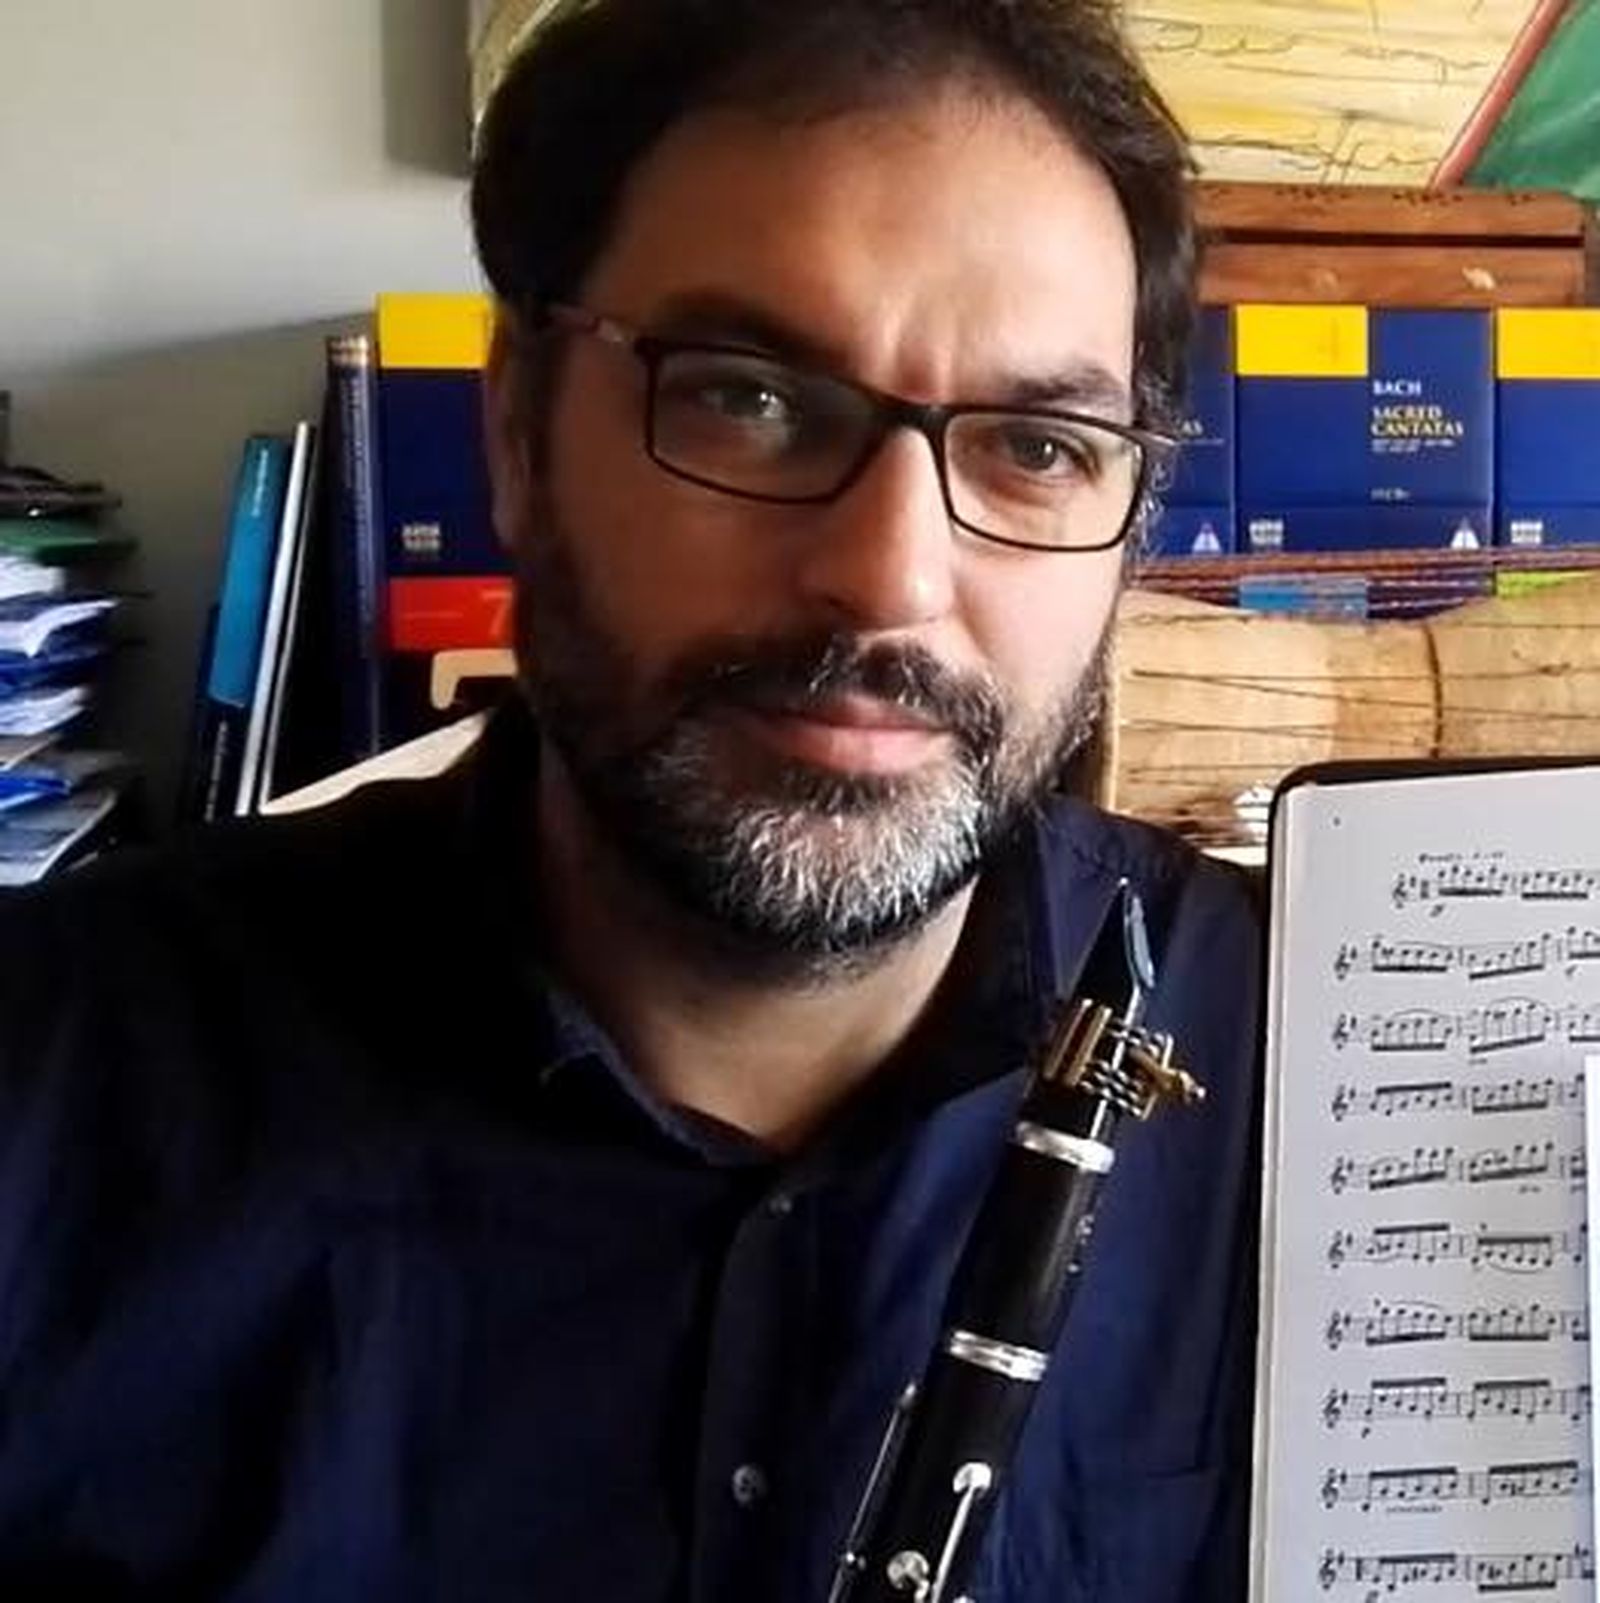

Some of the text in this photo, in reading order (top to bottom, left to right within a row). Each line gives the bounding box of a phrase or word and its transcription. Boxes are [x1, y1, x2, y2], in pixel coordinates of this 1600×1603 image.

[1372, 380, 1422, 396] BACH
[1372, 406, 1443, 420] SACRED
[1370, 420, 1465, 437] CANTATAS
